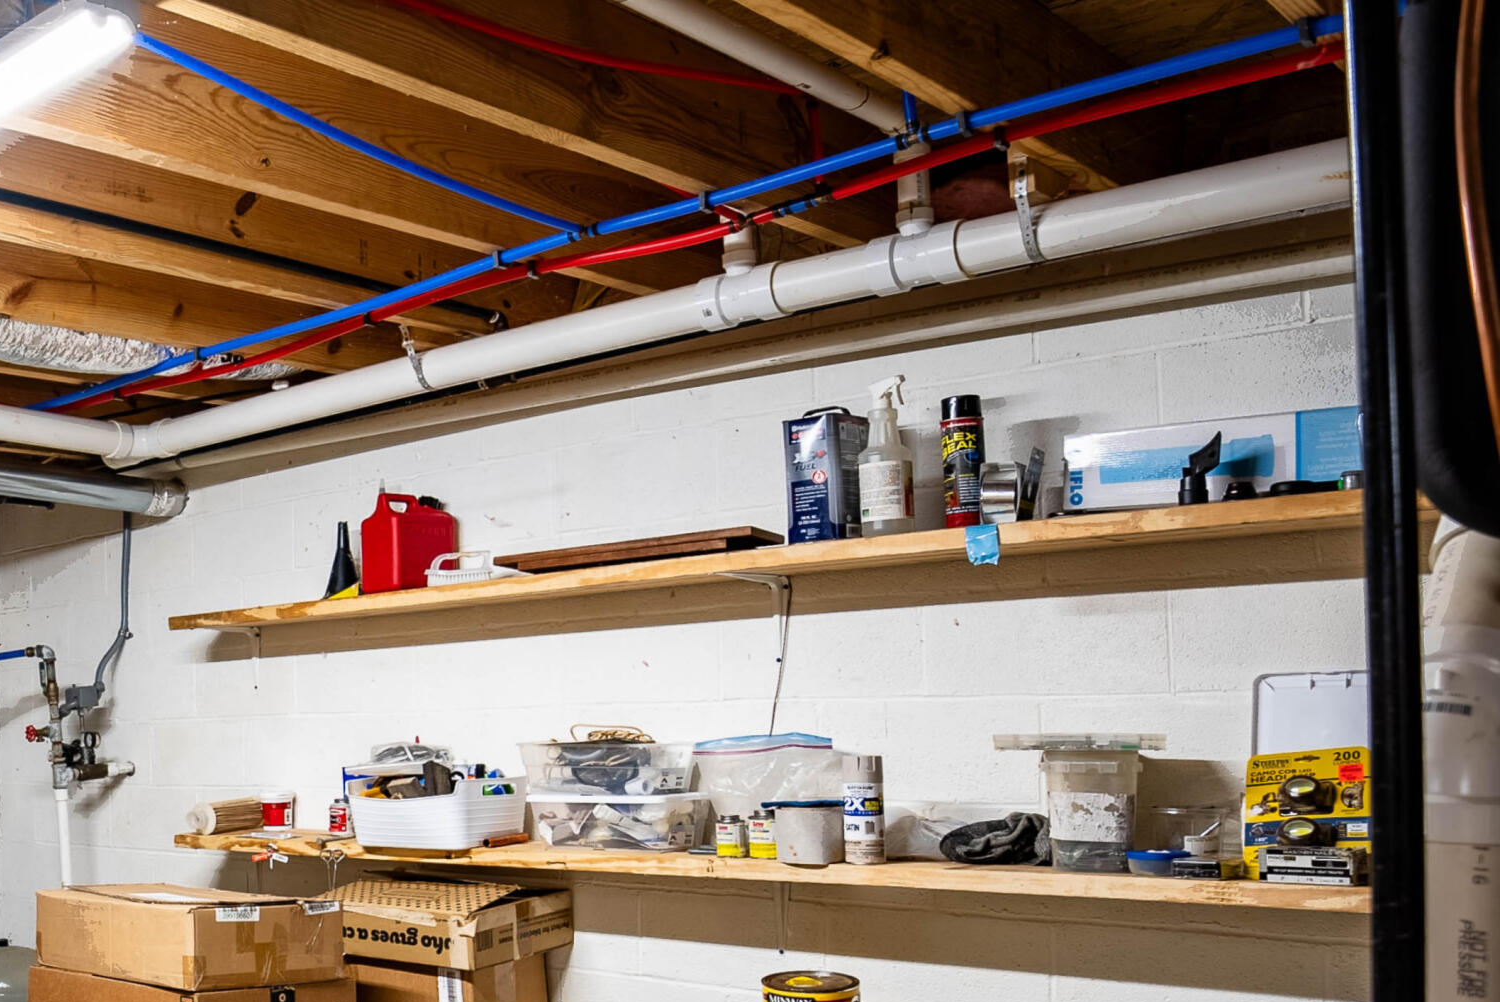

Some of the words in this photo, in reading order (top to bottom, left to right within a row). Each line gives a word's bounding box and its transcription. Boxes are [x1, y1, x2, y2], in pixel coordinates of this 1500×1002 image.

[941, 431, 977, 447] FLEX
[942, 440, 977, 460] SEAL
[1333, 750, 1361, 761] 200
[844, 796, 865, 811] 2X
[371, 927, 419, 947] gives
